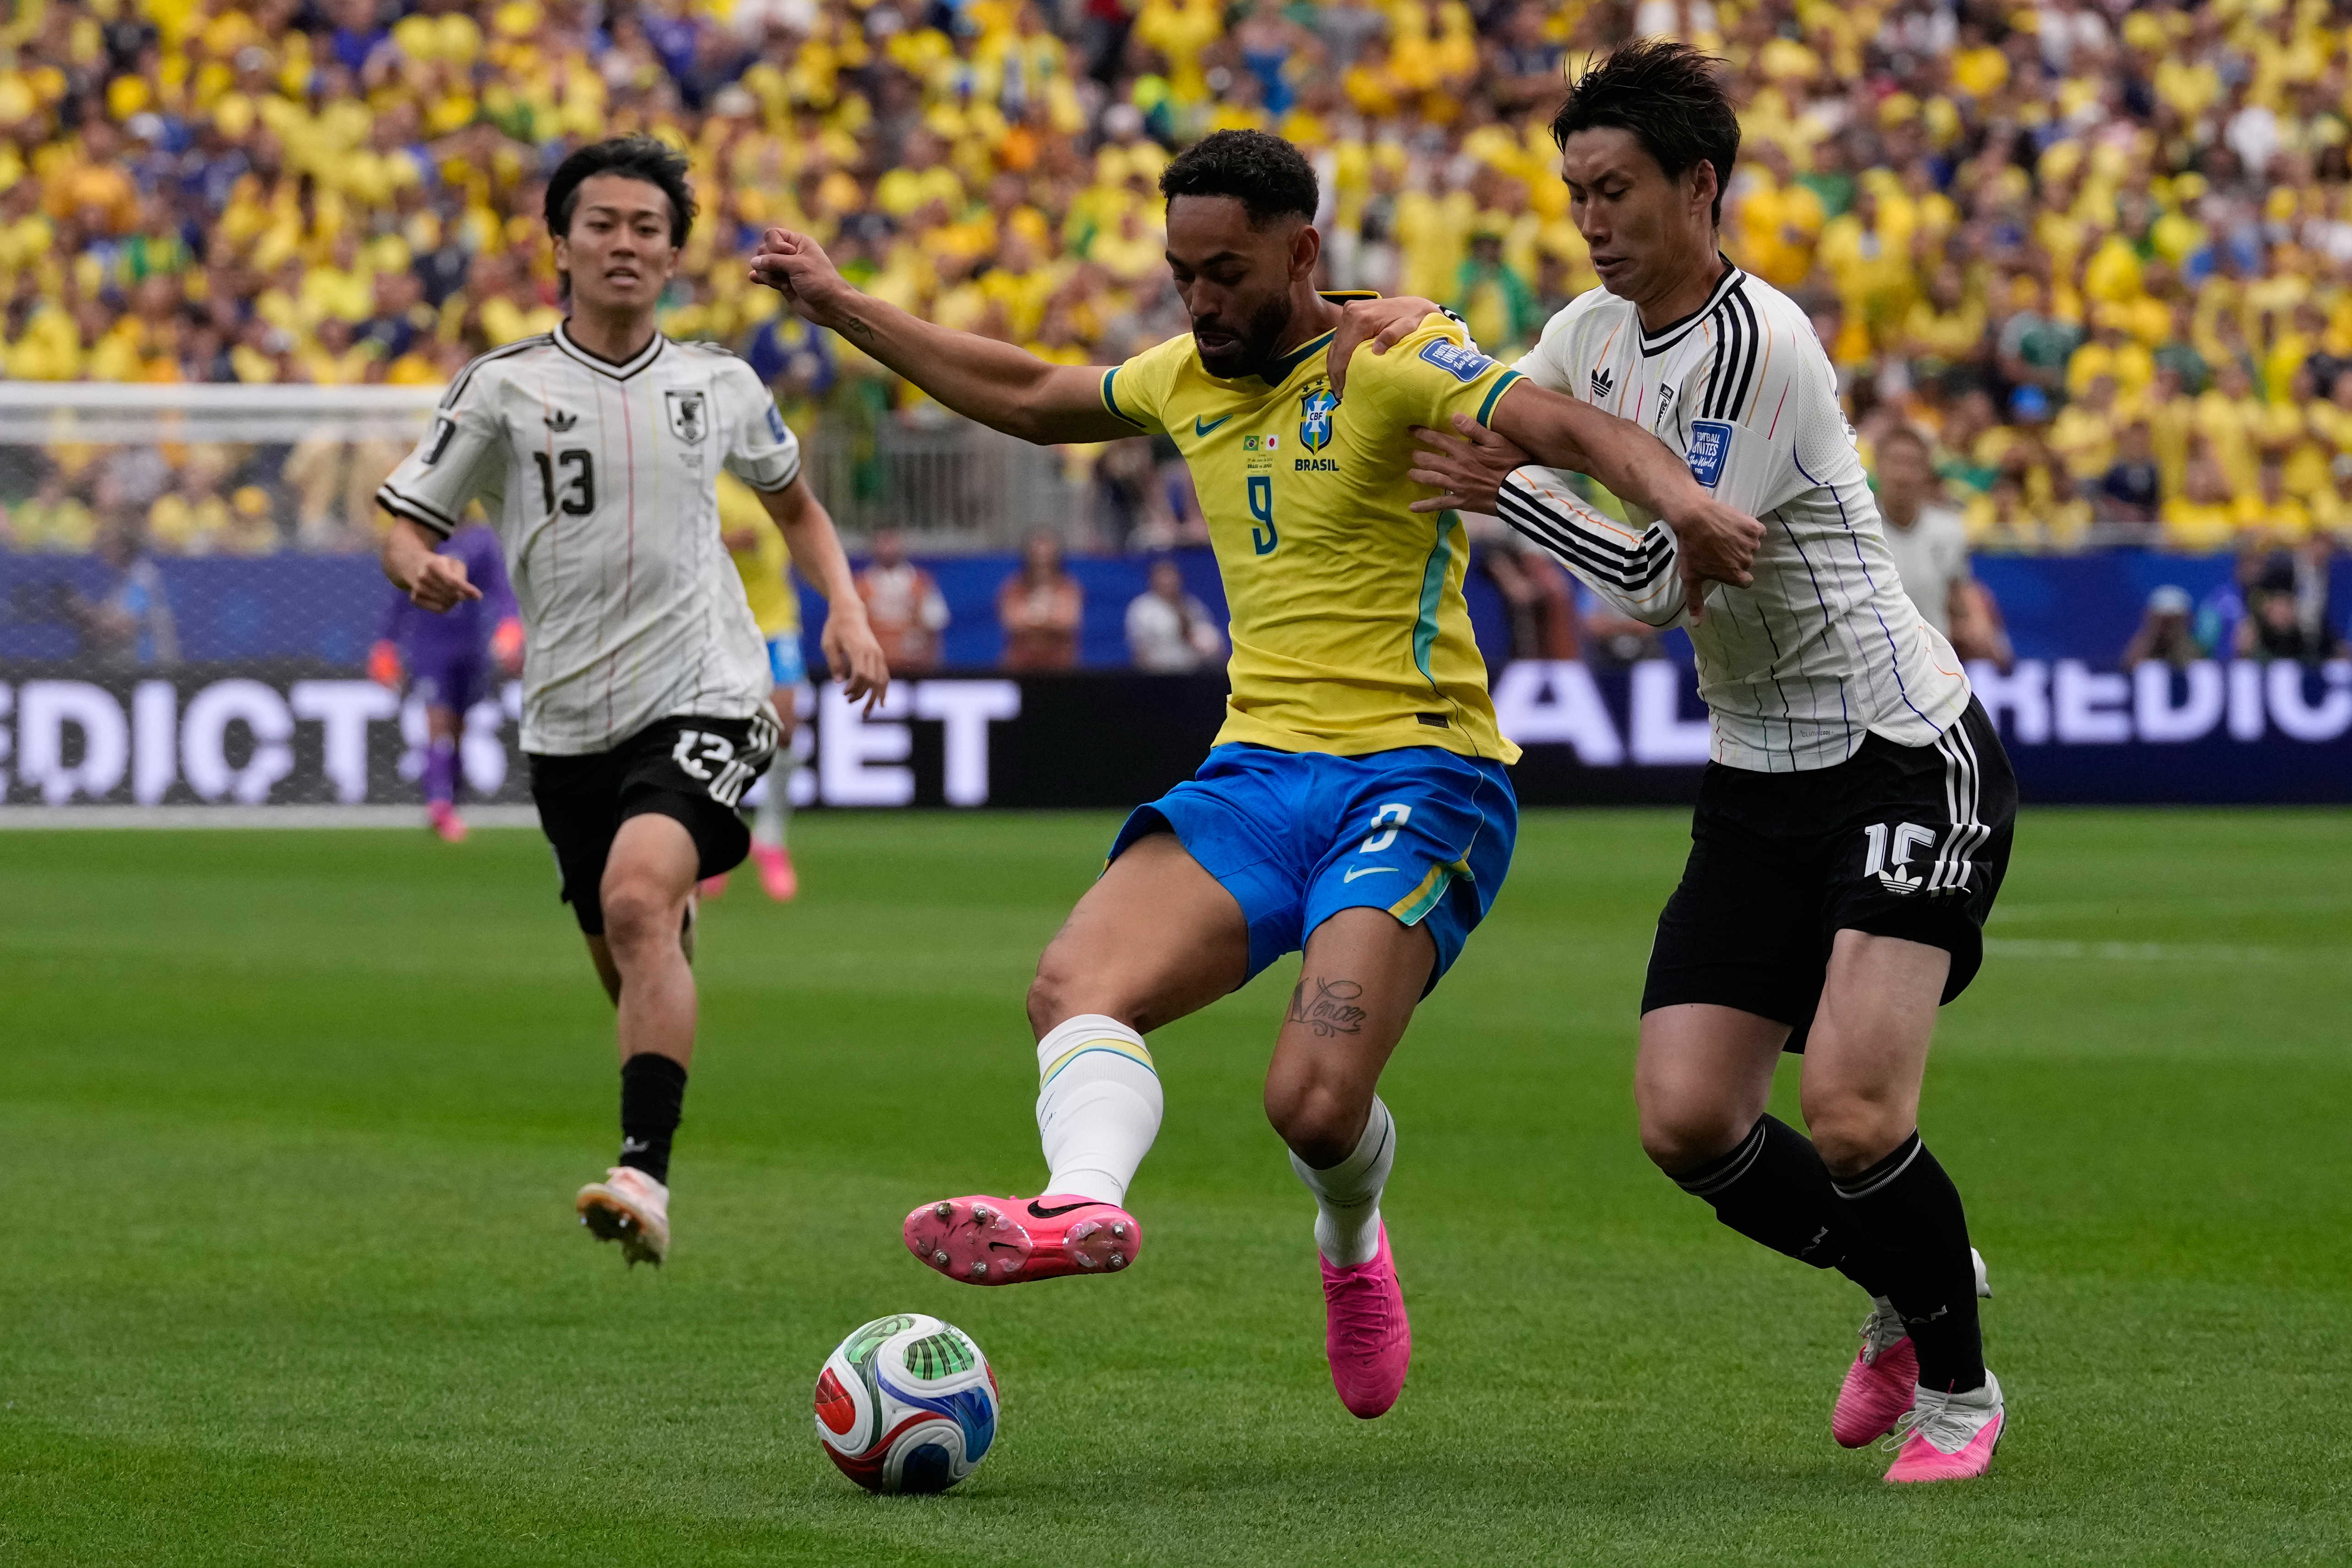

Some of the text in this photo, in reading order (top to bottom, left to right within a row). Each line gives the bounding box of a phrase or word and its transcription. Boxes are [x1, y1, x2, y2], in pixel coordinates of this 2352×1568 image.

[1468, 360, 1480, 368] FIFA
[1295, 459, 1340, 471] BRASIL
[1689, 454, 1718, 470] the World
[534, 448, 595, 516] 13
[1247, 475, 1278, 555] 9
